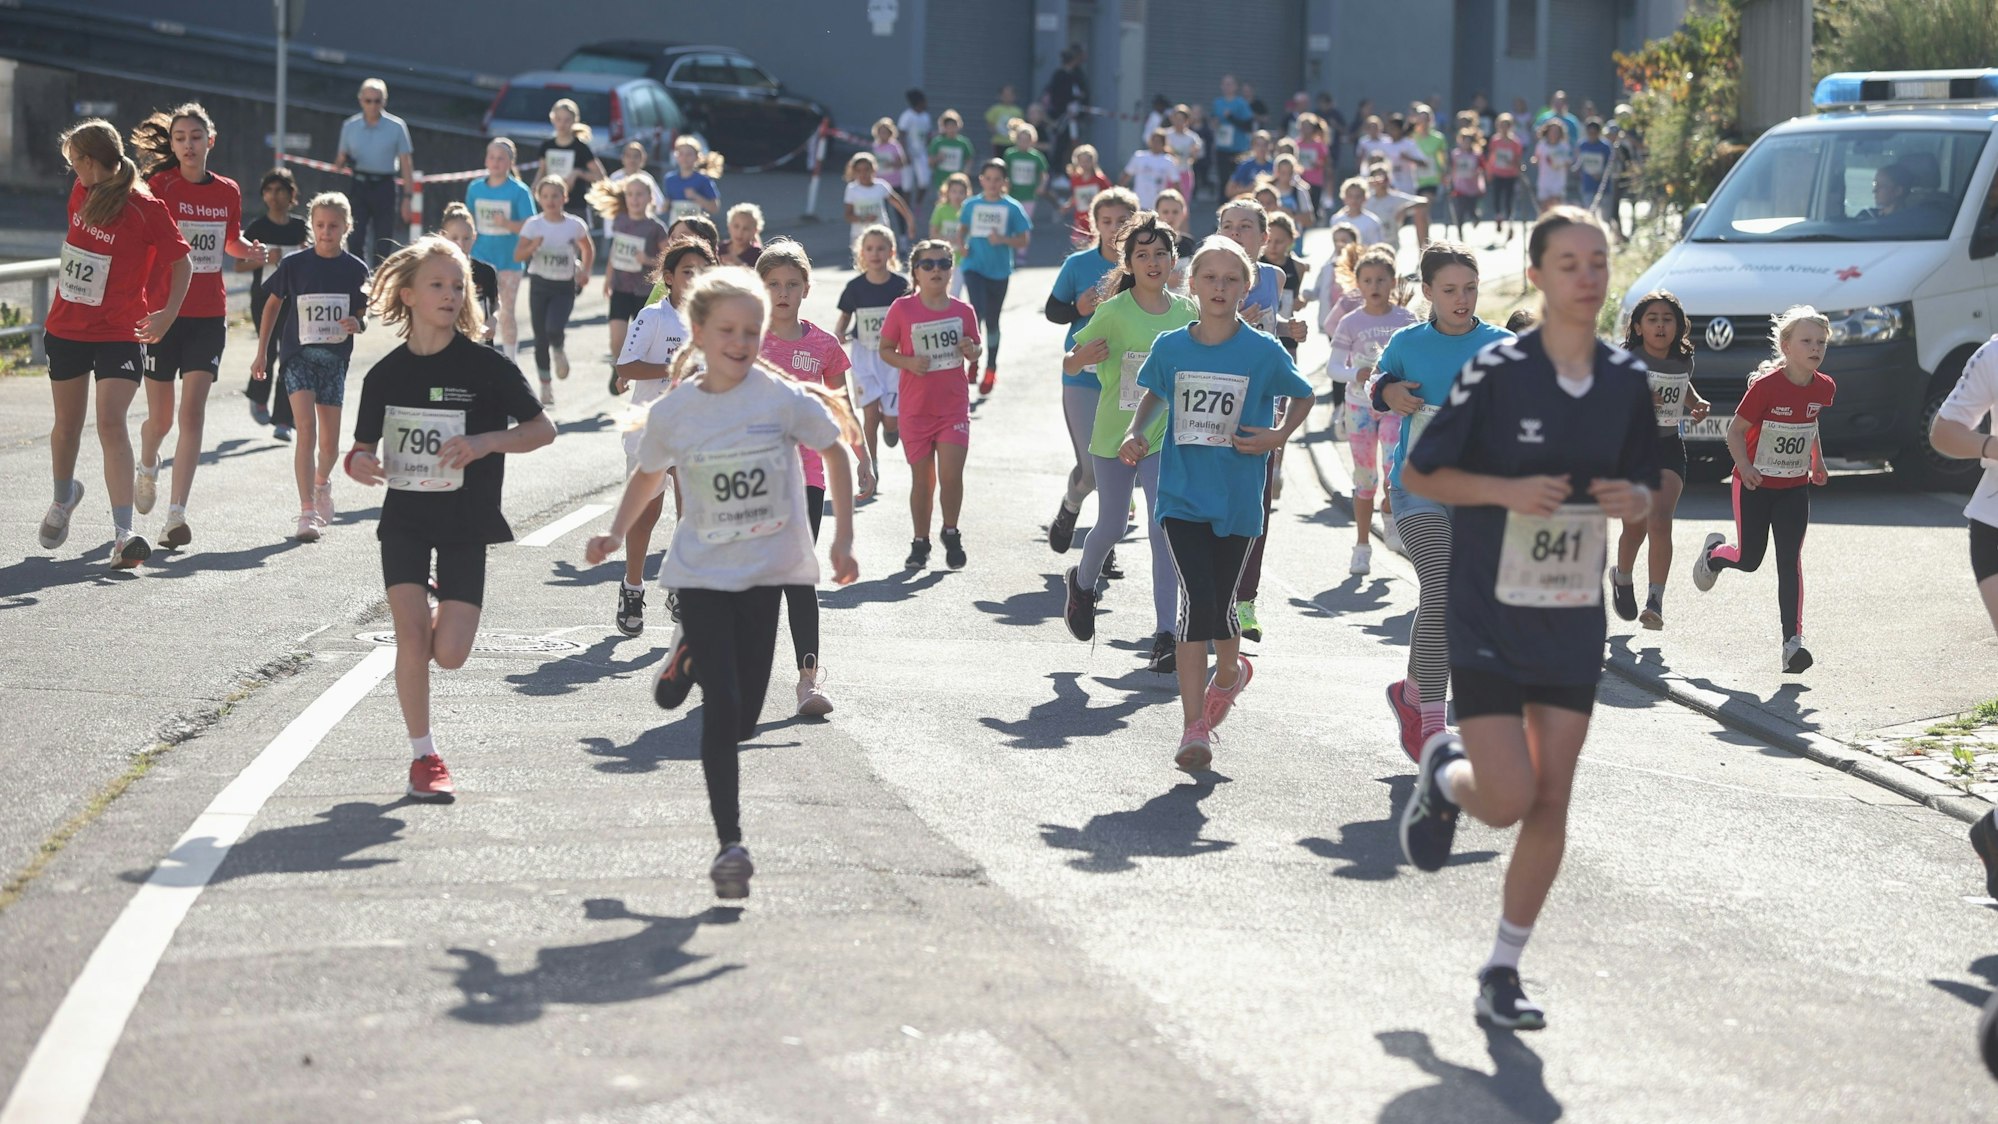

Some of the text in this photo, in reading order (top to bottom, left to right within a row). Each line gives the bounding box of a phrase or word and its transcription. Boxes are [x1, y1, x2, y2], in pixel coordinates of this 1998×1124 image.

[180, 202, 228, 219] RS Hepel
[190, 233, 216, 251] 403
[65, 260, 94, 283] 412
[305, 305, 342, 322] 1210
[921, 329, 958, 350] 1199
[792, 354, 820, 374] OUT
[1182, 389, 1235, 416] 1276
[1189, 420, 1221, 431] Pauline
[1706, 419, 1721, 436] RK
[398, 427, 442, 456] 796
[1774, 436, 1806, 455] 360
[713, 468, 768, 502] 962
[1532, 530, 1582, 563] 841
